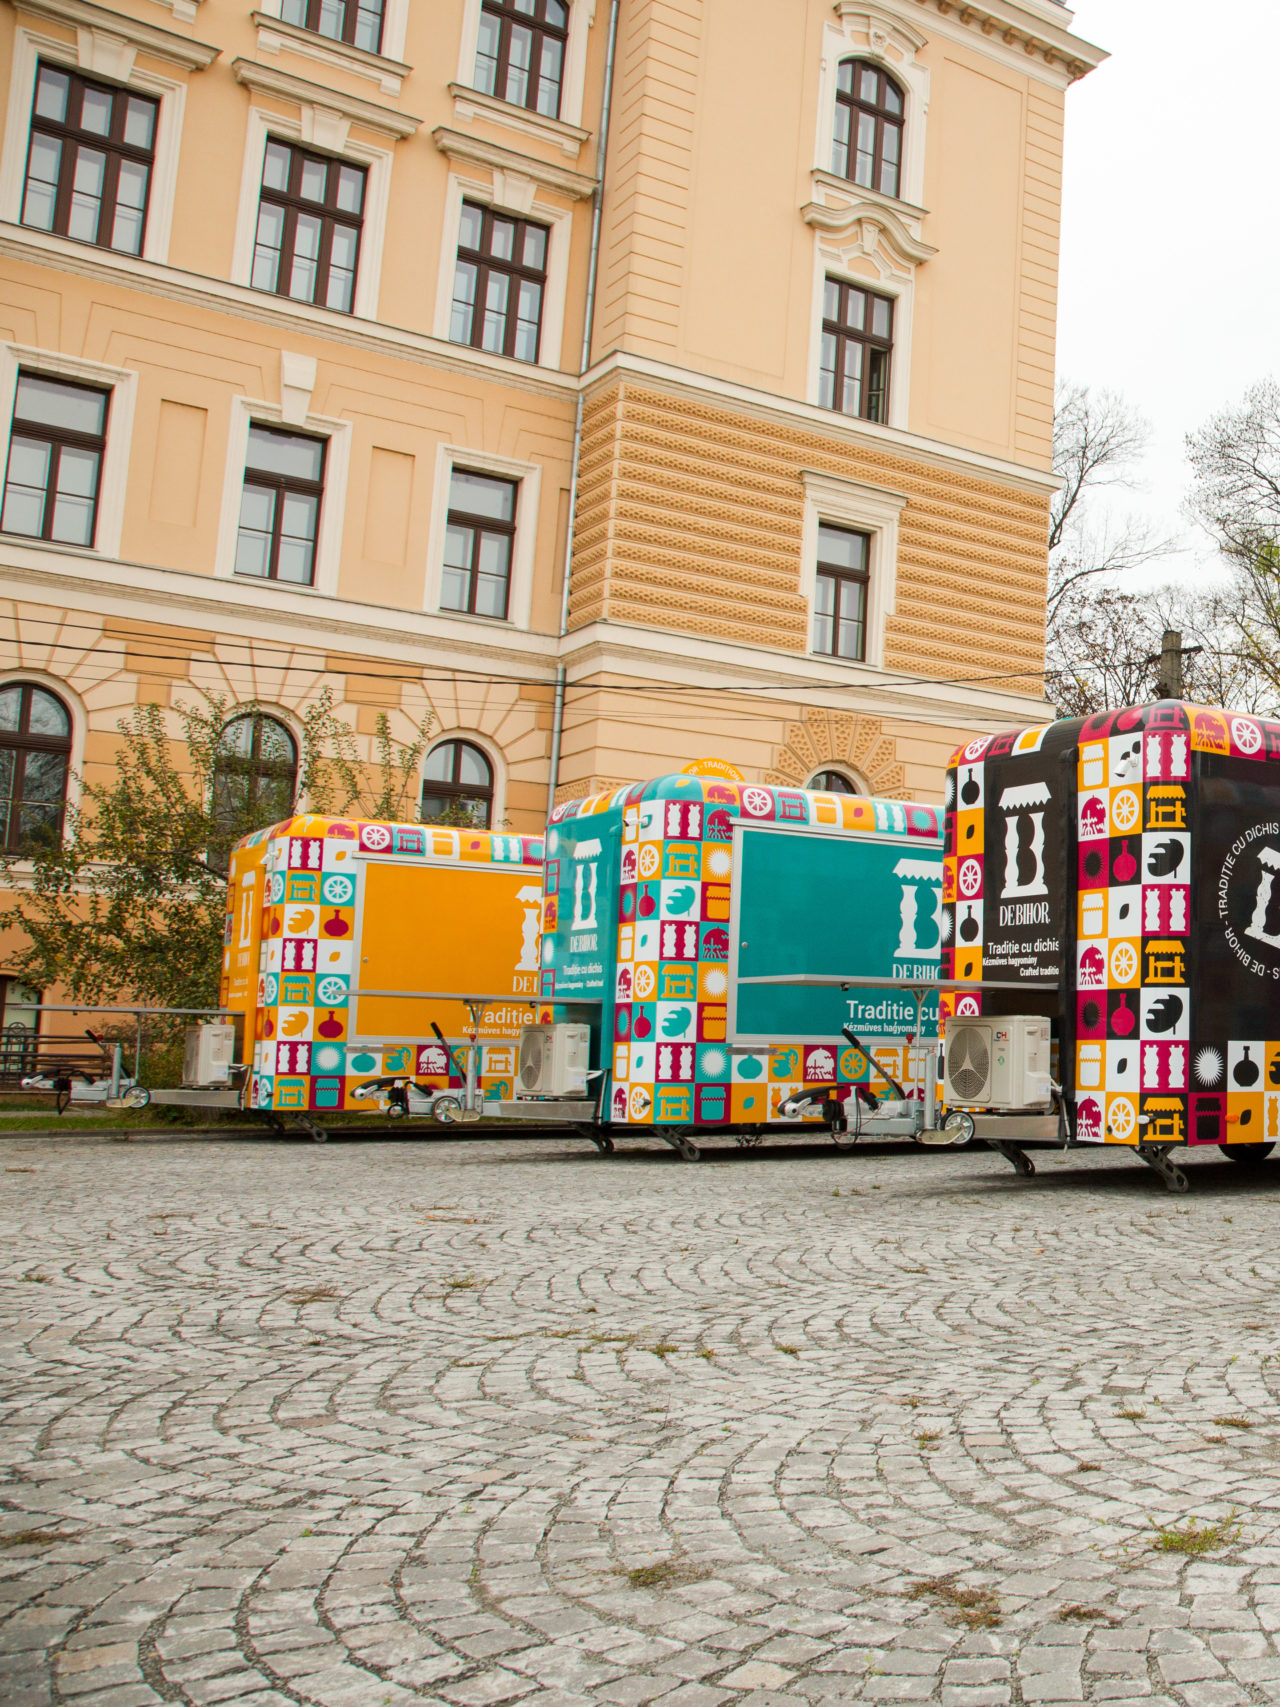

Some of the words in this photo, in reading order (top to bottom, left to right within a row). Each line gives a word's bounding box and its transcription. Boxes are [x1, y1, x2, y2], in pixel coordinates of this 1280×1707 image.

[1231, 836, 1246, 855] CU
[1021, 942, 1032, 953] cu
[1224, 927, 1251, 967] BIHOR
